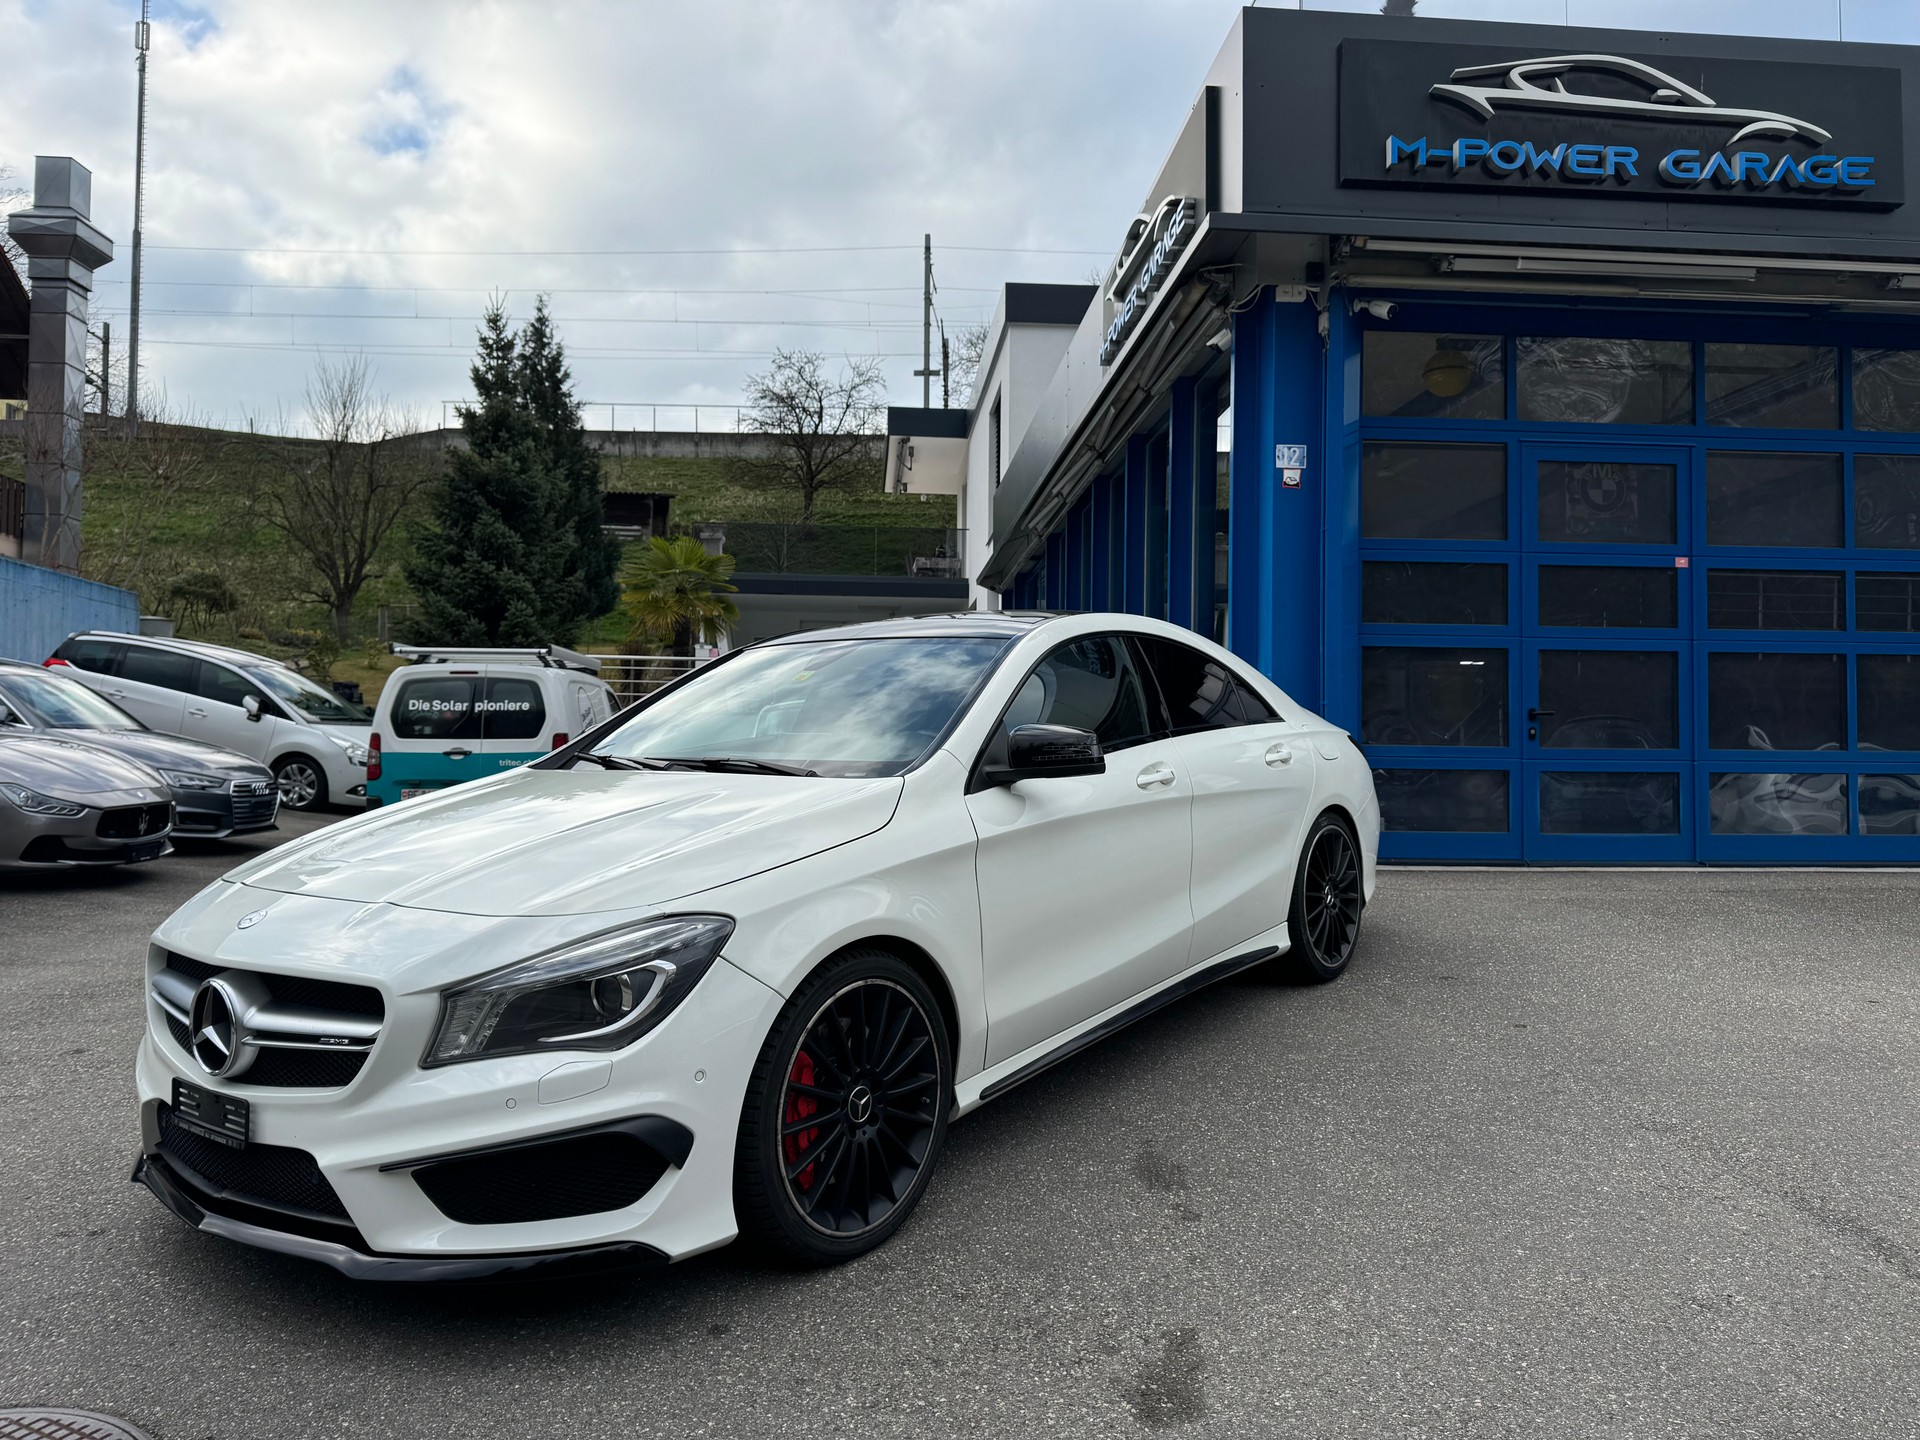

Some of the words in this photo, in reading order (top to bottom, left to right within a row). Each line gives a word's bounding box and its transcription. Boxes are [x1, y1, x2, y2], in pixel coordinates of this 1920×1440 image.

[1387, 135, 1639, 177] M-POWER
[1659, 149, 1876, 187] GARAGE
[1140, 198, 1186, 293] GARAGE
[408, 699, 430, 711] Die
[432, 699, 469, 711] Solar
[474, 699, 530, 713] pioniere
